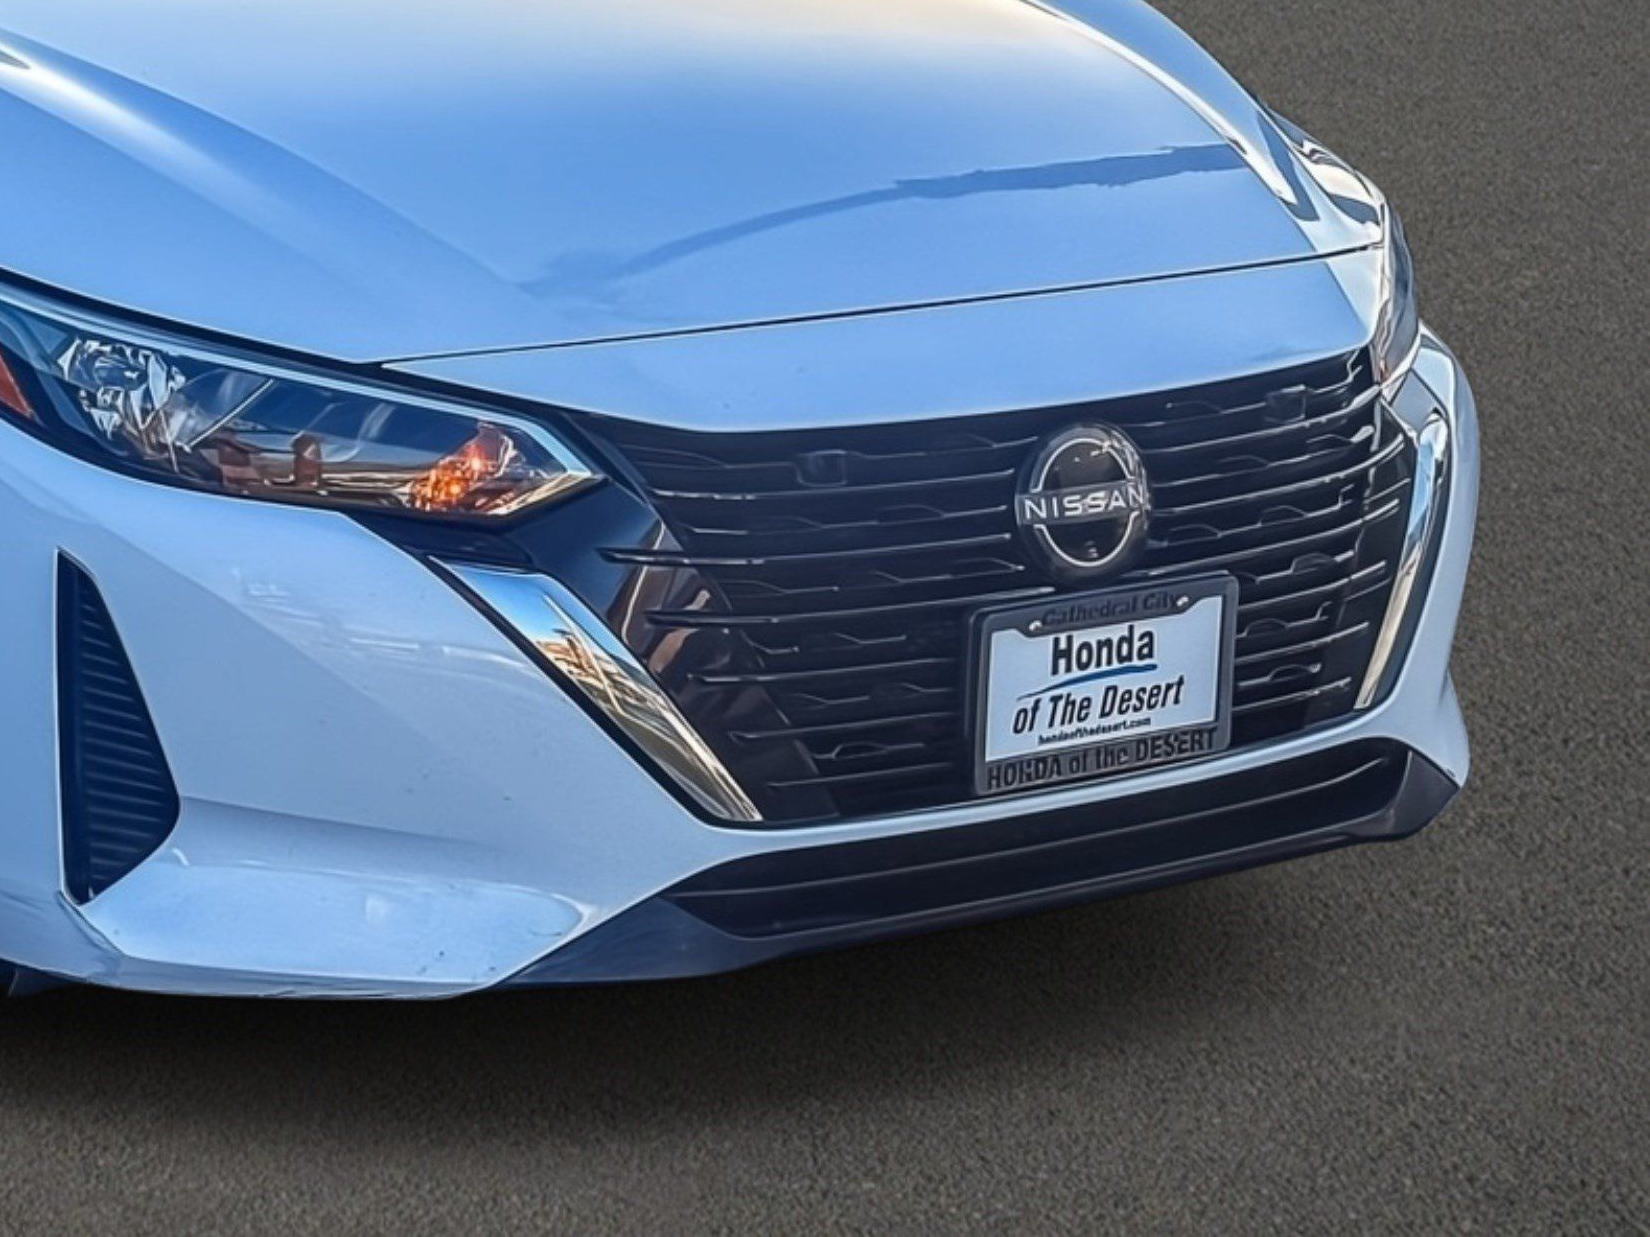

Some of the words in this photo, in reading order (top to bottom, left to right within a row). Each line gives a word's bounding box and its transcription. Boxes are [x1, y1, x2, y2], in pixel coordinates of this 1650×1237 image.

[1023, 483, 1144, 520] NISSAN
[1051, 624, 1155, 676] Honda
[1012, 697, 1042, 734] of
[1048, 691, 1092, 729] The
[1098, 674, 1184, 719] Desert
[986, 752, 1062, 790] HONDA
[1069, 748, 1090, 774] of
[1096, 742, 1130, 769] the
[1136, 725, 1218, 761] DESERT
